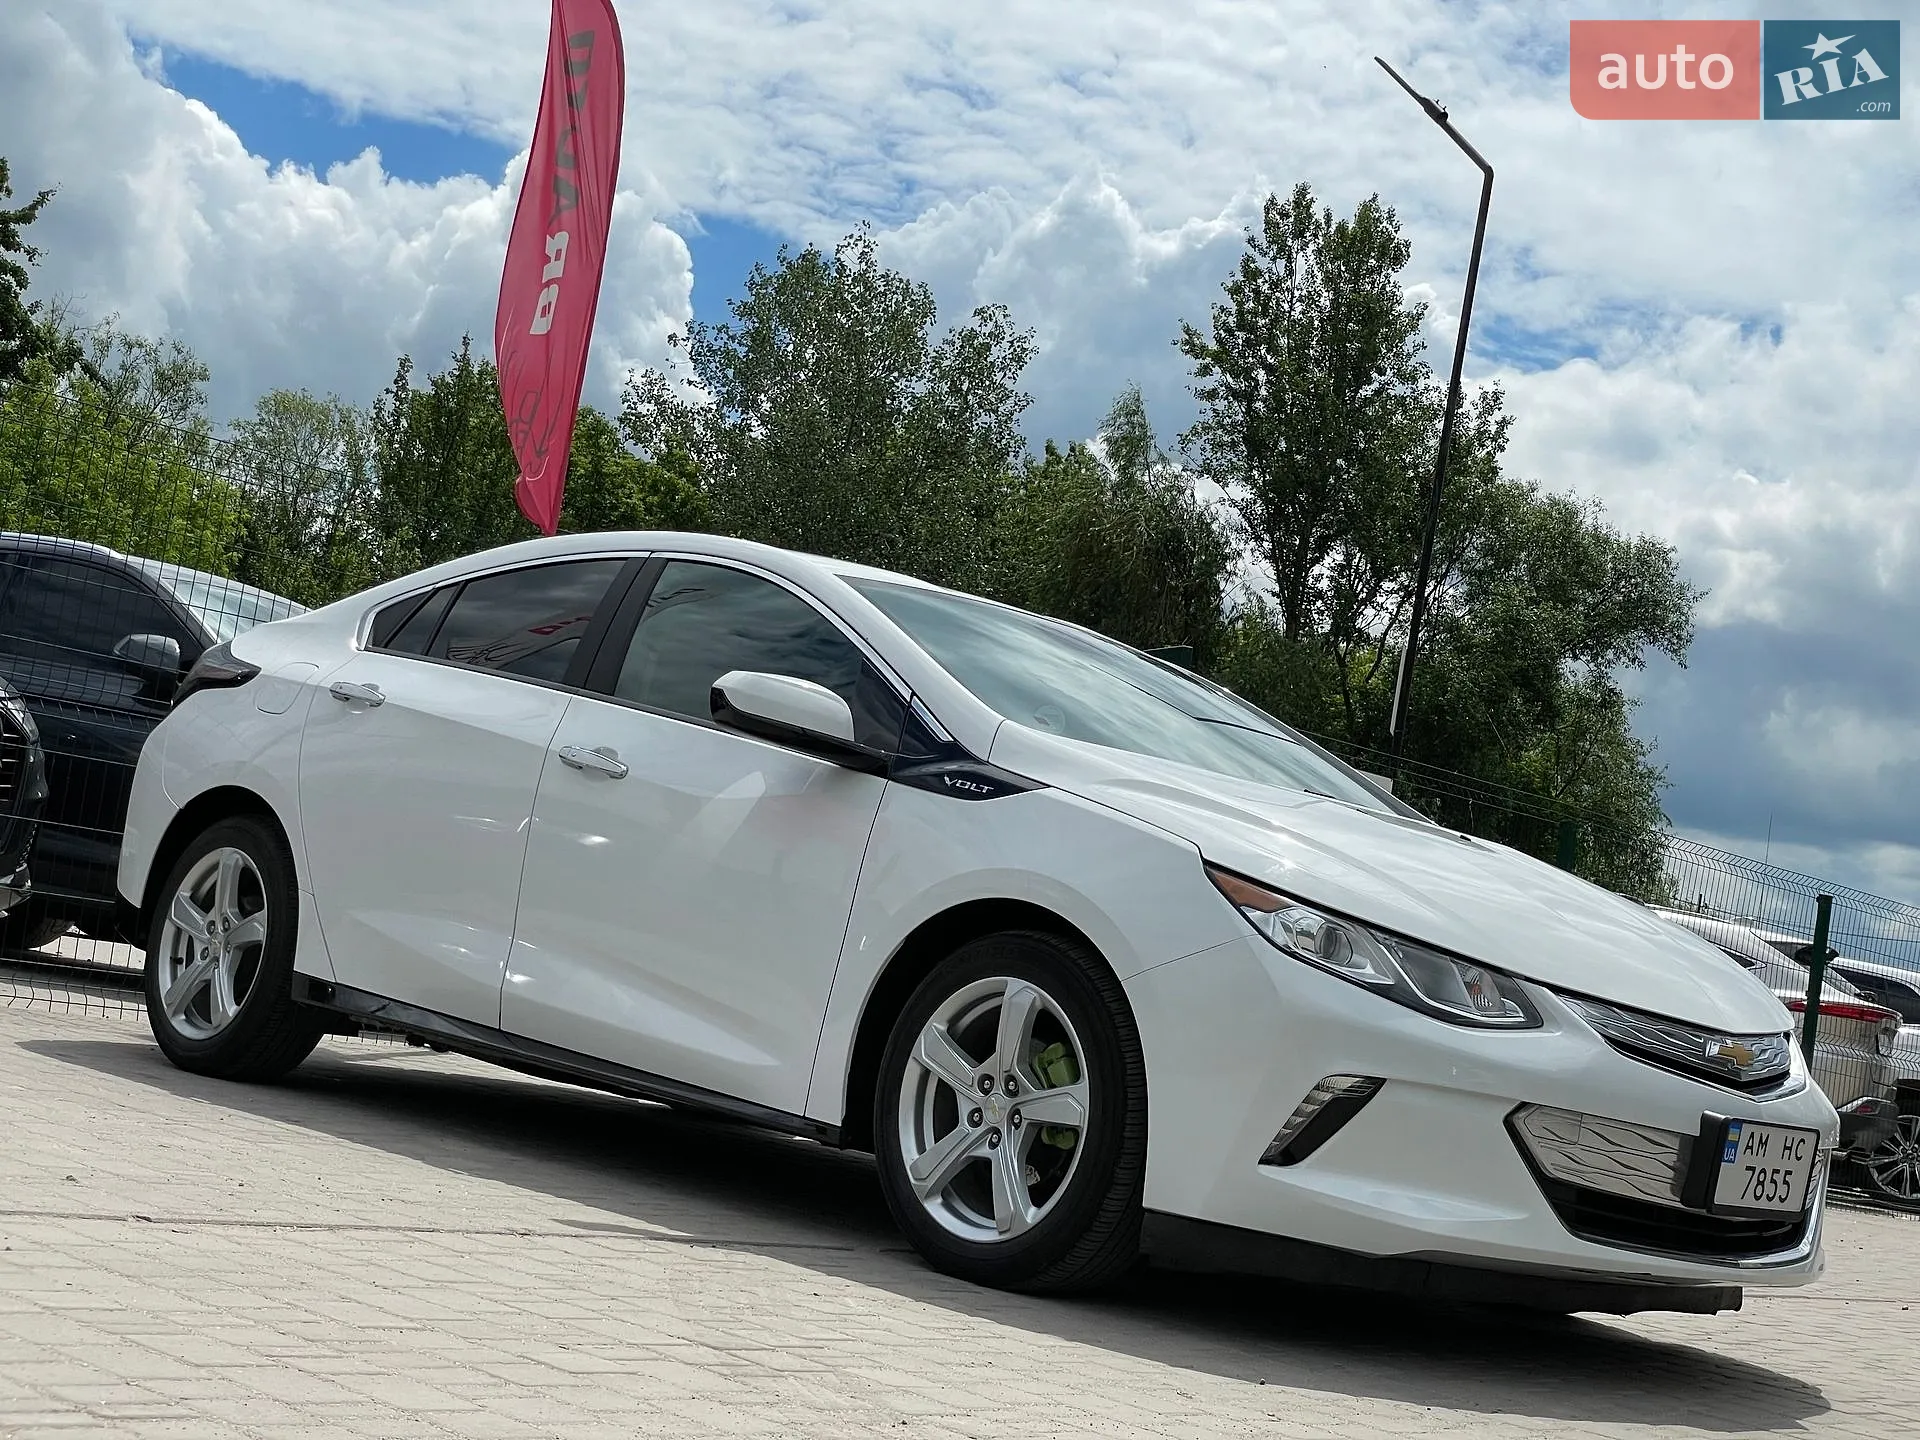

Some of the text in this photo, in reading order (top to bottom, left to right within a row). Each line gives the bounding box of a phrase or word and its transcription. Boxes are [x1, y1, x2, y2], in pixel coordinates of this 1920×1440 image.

[944, 774, 995, 793] VOLT
[1724, 1147, 1736, 1161] UA
[1743, 1131, 1806, 1161] AM HC
[1740, 1165, 1793, 1203] 7855
